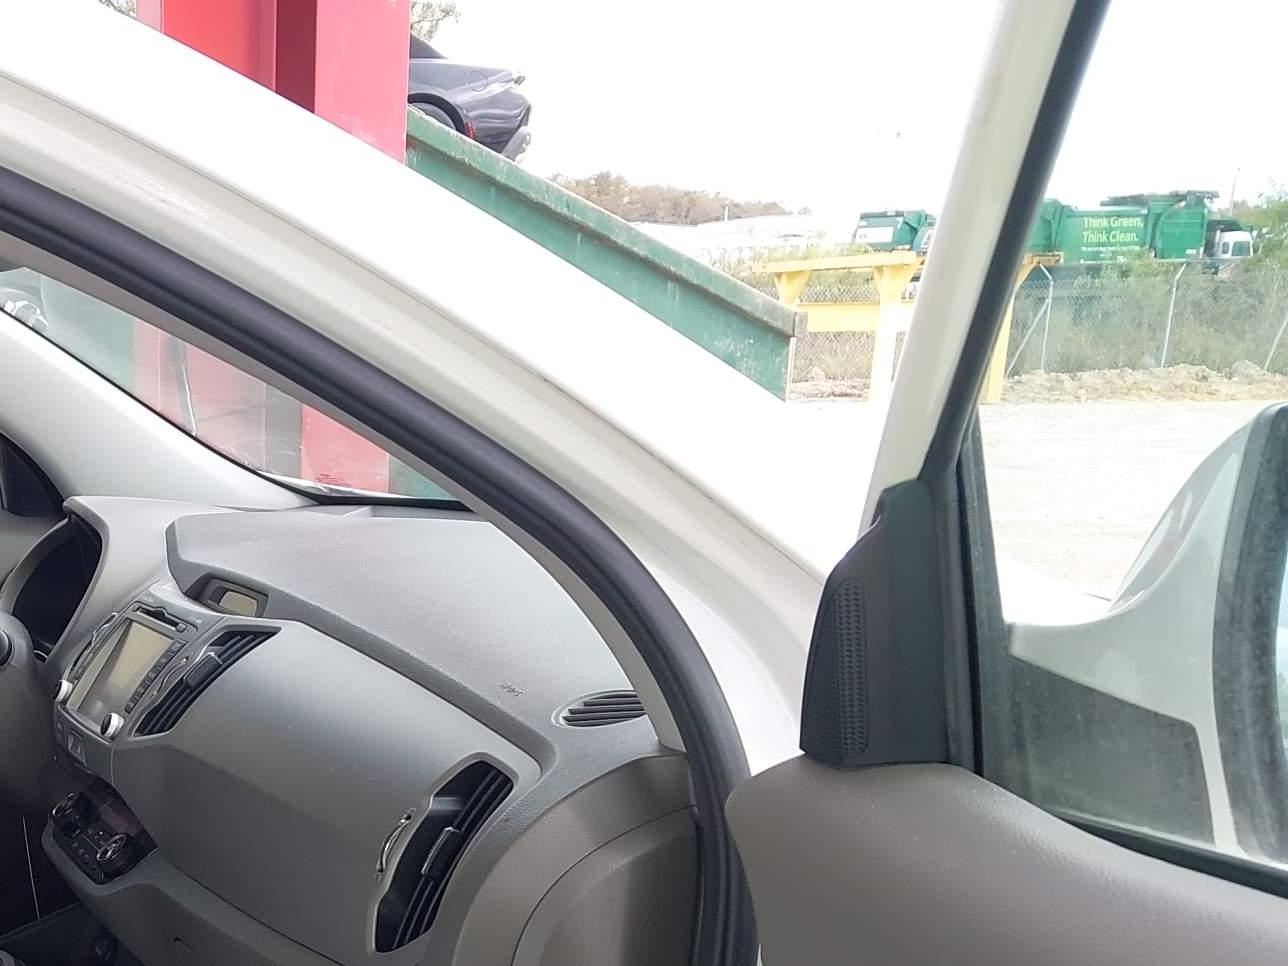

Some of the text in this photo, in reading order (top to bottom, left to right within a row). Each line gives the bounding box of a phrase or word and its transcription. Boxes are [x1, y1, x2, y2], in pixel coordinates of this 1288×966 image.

[1083, 216, 1144, 228] Think Green,
[1082, 230, 1108, 242] Think
